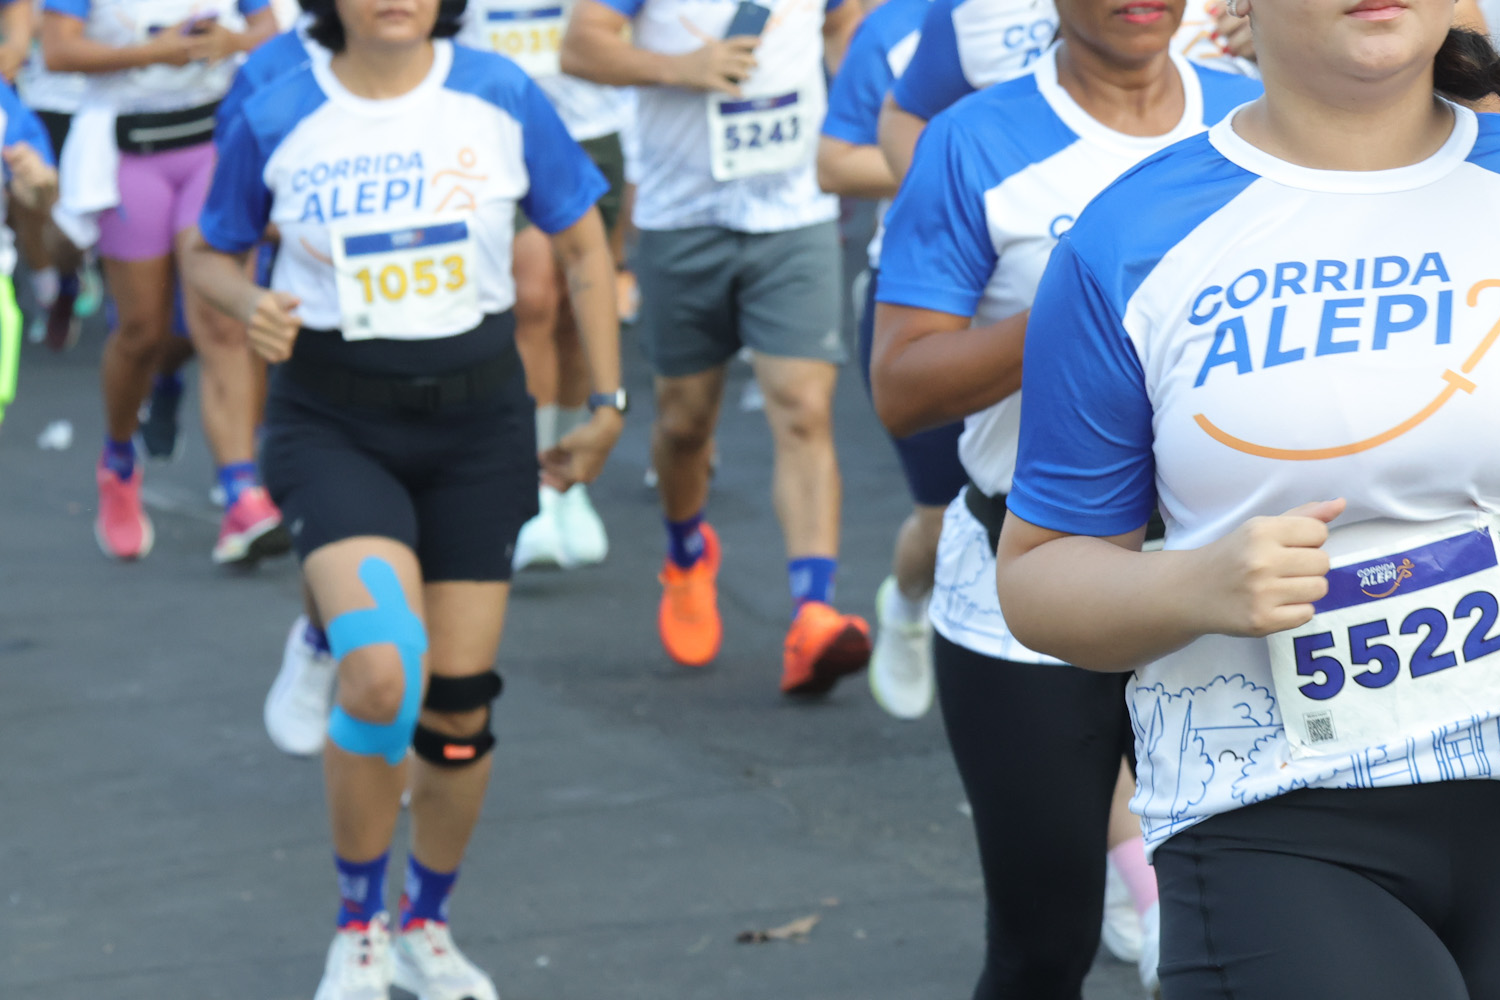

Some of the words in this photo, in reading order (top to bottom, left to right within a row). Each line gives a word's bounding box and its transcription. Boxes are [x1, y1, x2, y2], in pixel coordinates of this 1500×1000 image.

[291, 151, 424, 193] CORRIDA
[299, 177, 424, 224] ALEPI
[355, 253, 467, 304] 1053
[1187, 251, 1451, 326] CORRIDA
[1193, 289, 1454, 388] ALEPI
[1356, 561, 1397, 579] CORRIDA
[1359, 568, 1398, 588] ALEPI
